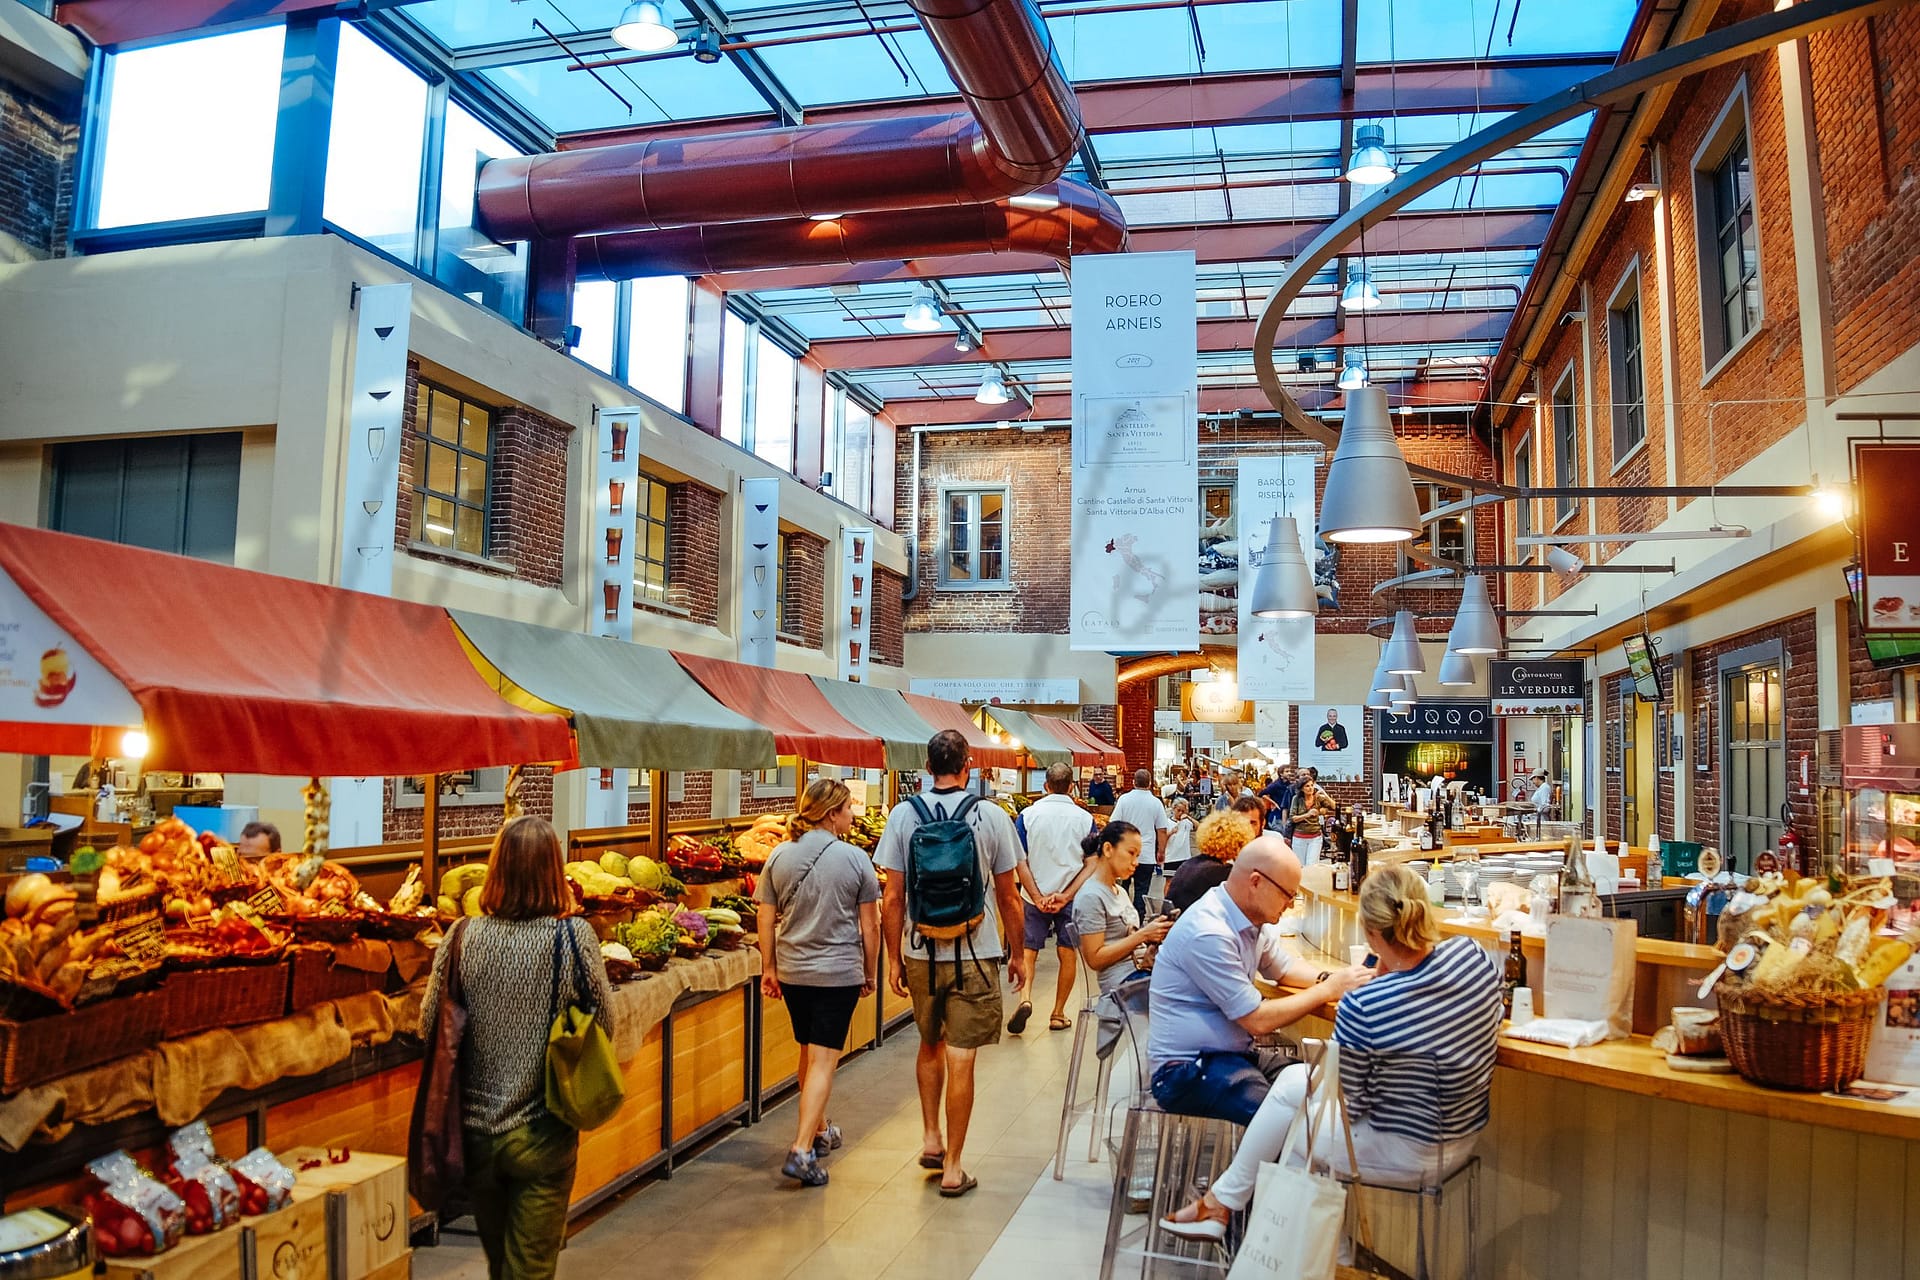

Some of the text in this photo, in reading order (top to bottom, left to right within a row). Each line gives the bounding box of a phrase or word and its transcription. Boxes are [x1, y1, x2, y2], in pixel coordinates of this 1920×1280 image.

[1104, 293, 1162, 308] ROERO
[1105, 316, 1162, 330] ARNEIS
[1130, 430, 1163, 438] VITTORIA
[1257, 478, 1296, 487] BAROLO
[1257, 491, 1295, 499] RISERVA
[1106, 497, 1136, 505] Castello
[1145, 496, 1166, 504] Santa
[1086, 506, 1185, 516] Santa Vittoria D'Alba (CN)
[1501, 685, 1576, 695] LE VERDURE
